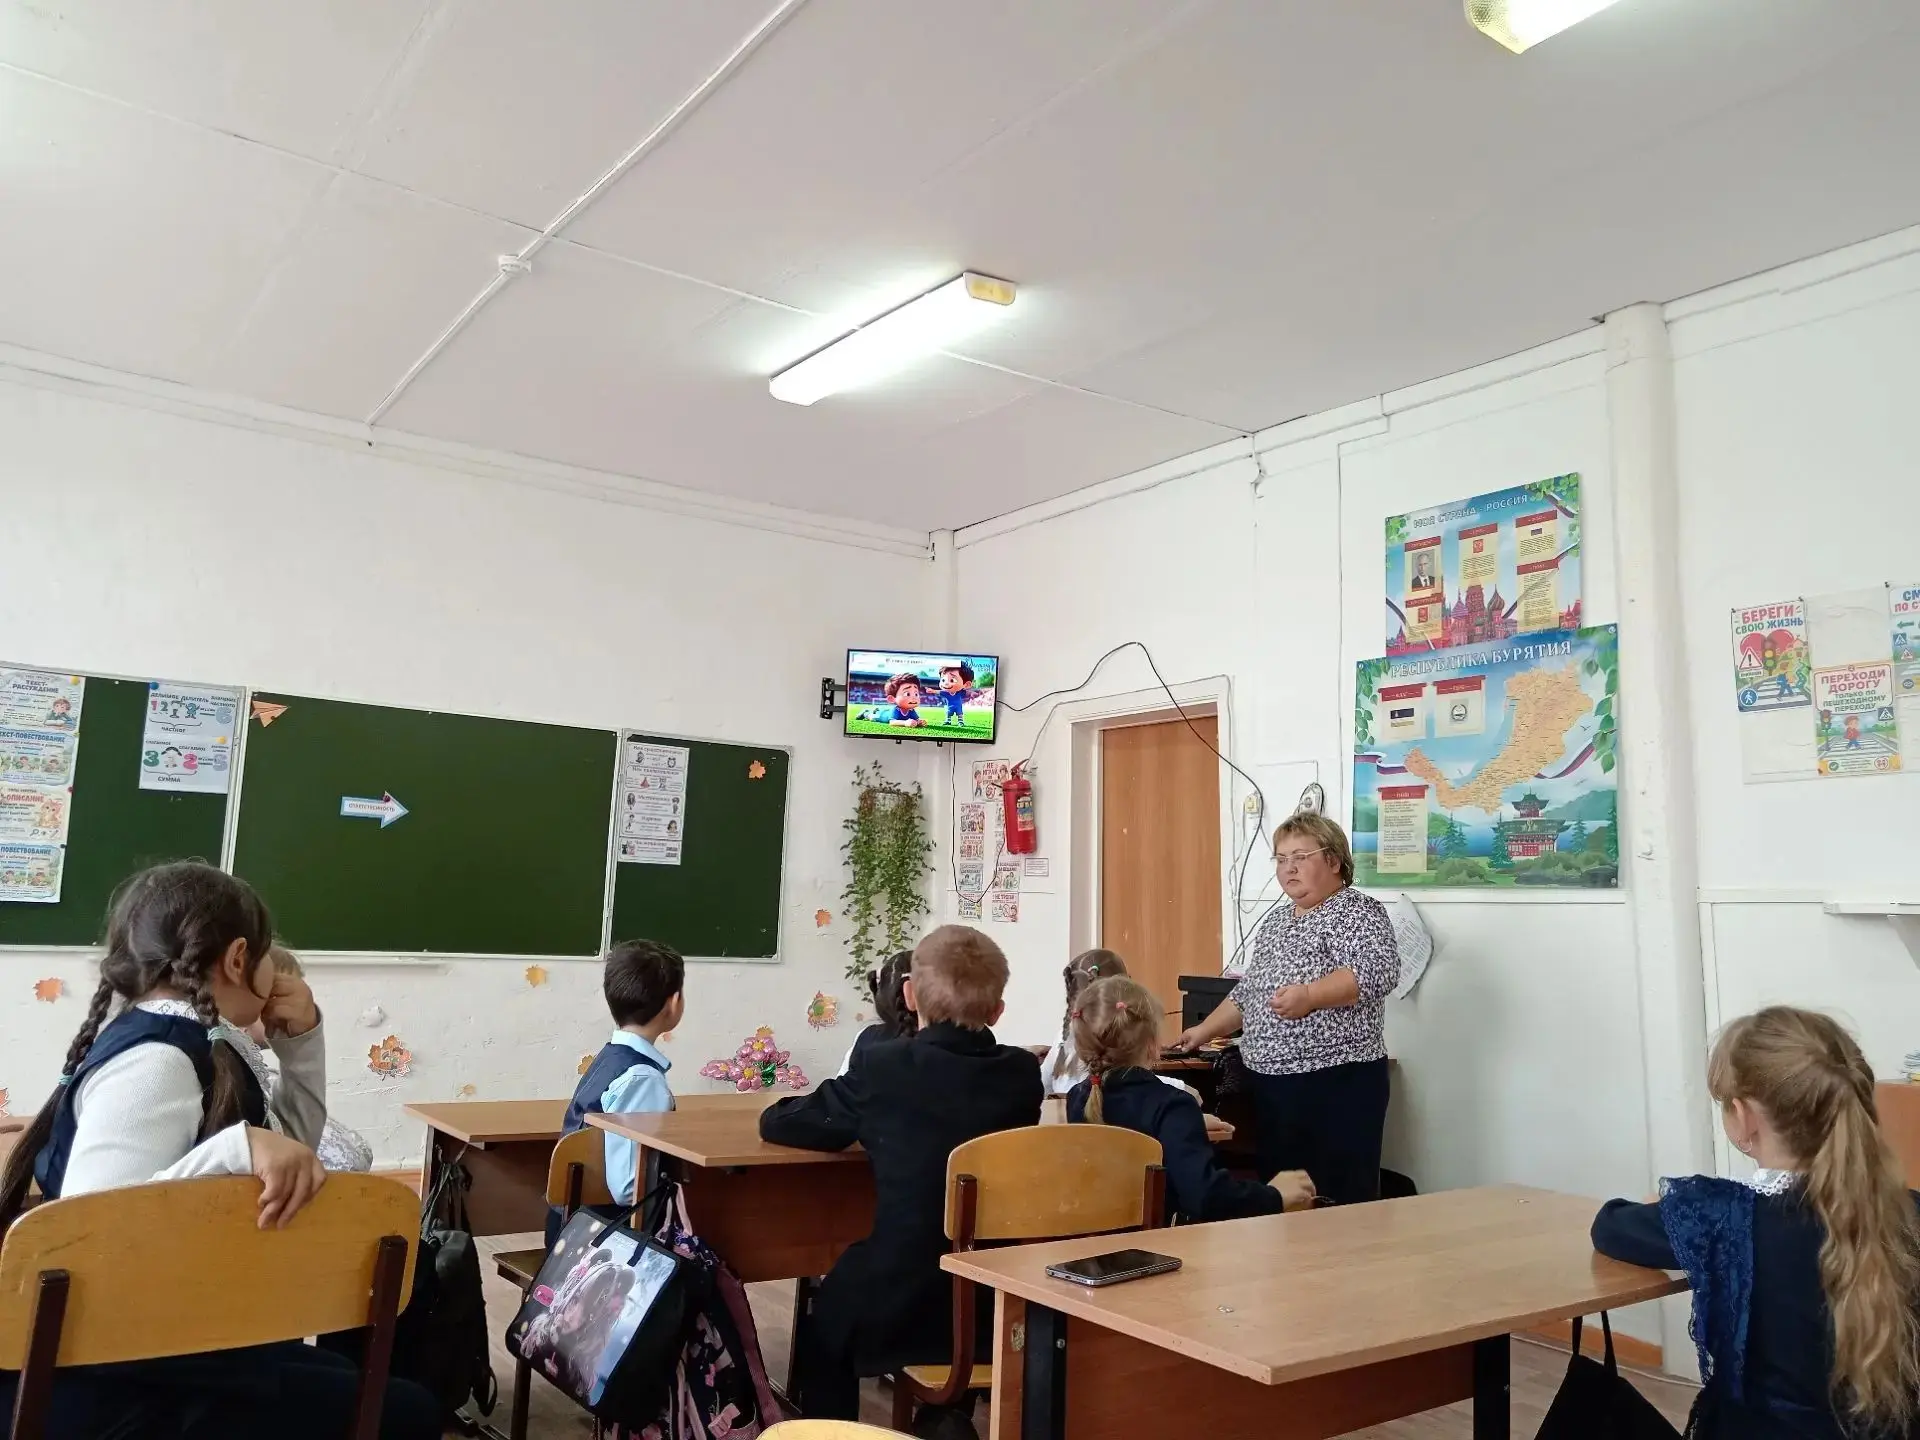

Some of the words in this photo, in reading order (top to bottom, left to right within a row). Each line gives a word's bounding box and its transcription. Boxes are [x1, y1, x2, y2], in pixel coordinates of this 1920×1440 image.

[1413, 515, 1435, 529] МОЯ
[1437, 507, 1477, 526] СТРАНА
[1486, 494, 1528, 512] РОССИЯ
[1741, 604, 1794, 625] БЕРЕГИ
[1894, 602, 1909, 613] ПО
[1735, 622, 1765, 635] СВОЮ
[1767, 617, 1804, 629] ЖИЗНЬ
[1390, 654, 1488, 678] РЕСПУБЛИКА
[1492, 640, 1572, 665] БУРЯТИЯ
[1821, 669, 1886, 684] ПЕРЕХОДИ
[12, 683, 60, 694] РАССУЖДЕНИЕ
[1828, 679, 1880, 695] ДОРОГУ
[181, 695, 209, 703] ДЕЛИТЕЛЬ
[1823, 694, 1887, 707] ПЕШЕХОДНОМУ
[1835, 691, 1863, 699] ТОЛЬКО
[1834, 703, 1877, 712] ПЕРЕХОДУ
[143, 750, 159, 767] 3
[183, 753, 198, 770] 2
